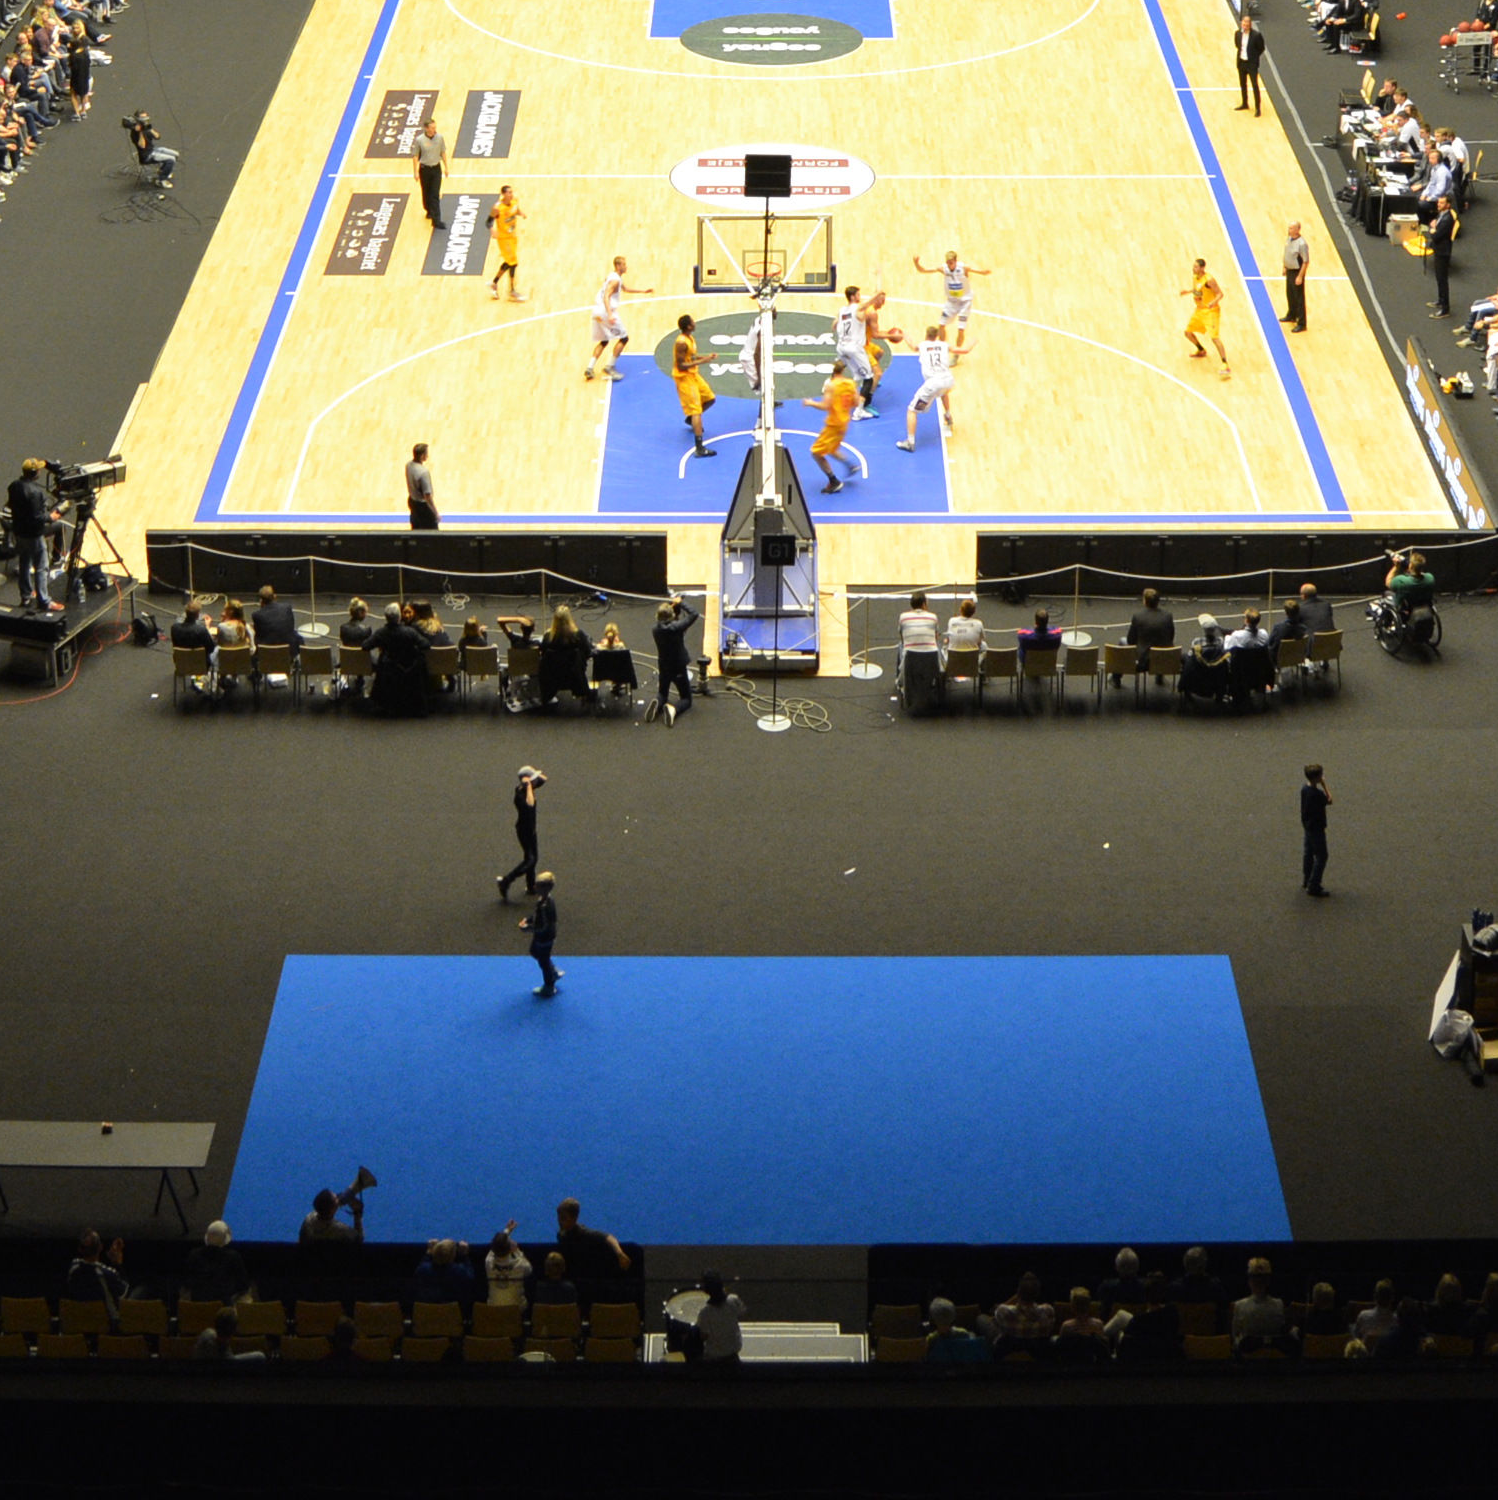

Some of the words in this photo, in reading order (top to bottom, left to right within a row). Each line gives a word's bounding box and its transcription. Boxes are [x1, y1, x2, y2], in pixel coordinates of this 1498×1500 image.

[359, 236, 389, 270] bageriet
[929, 352, 942, 367] 13
[768, 543, 790, 558] G1
